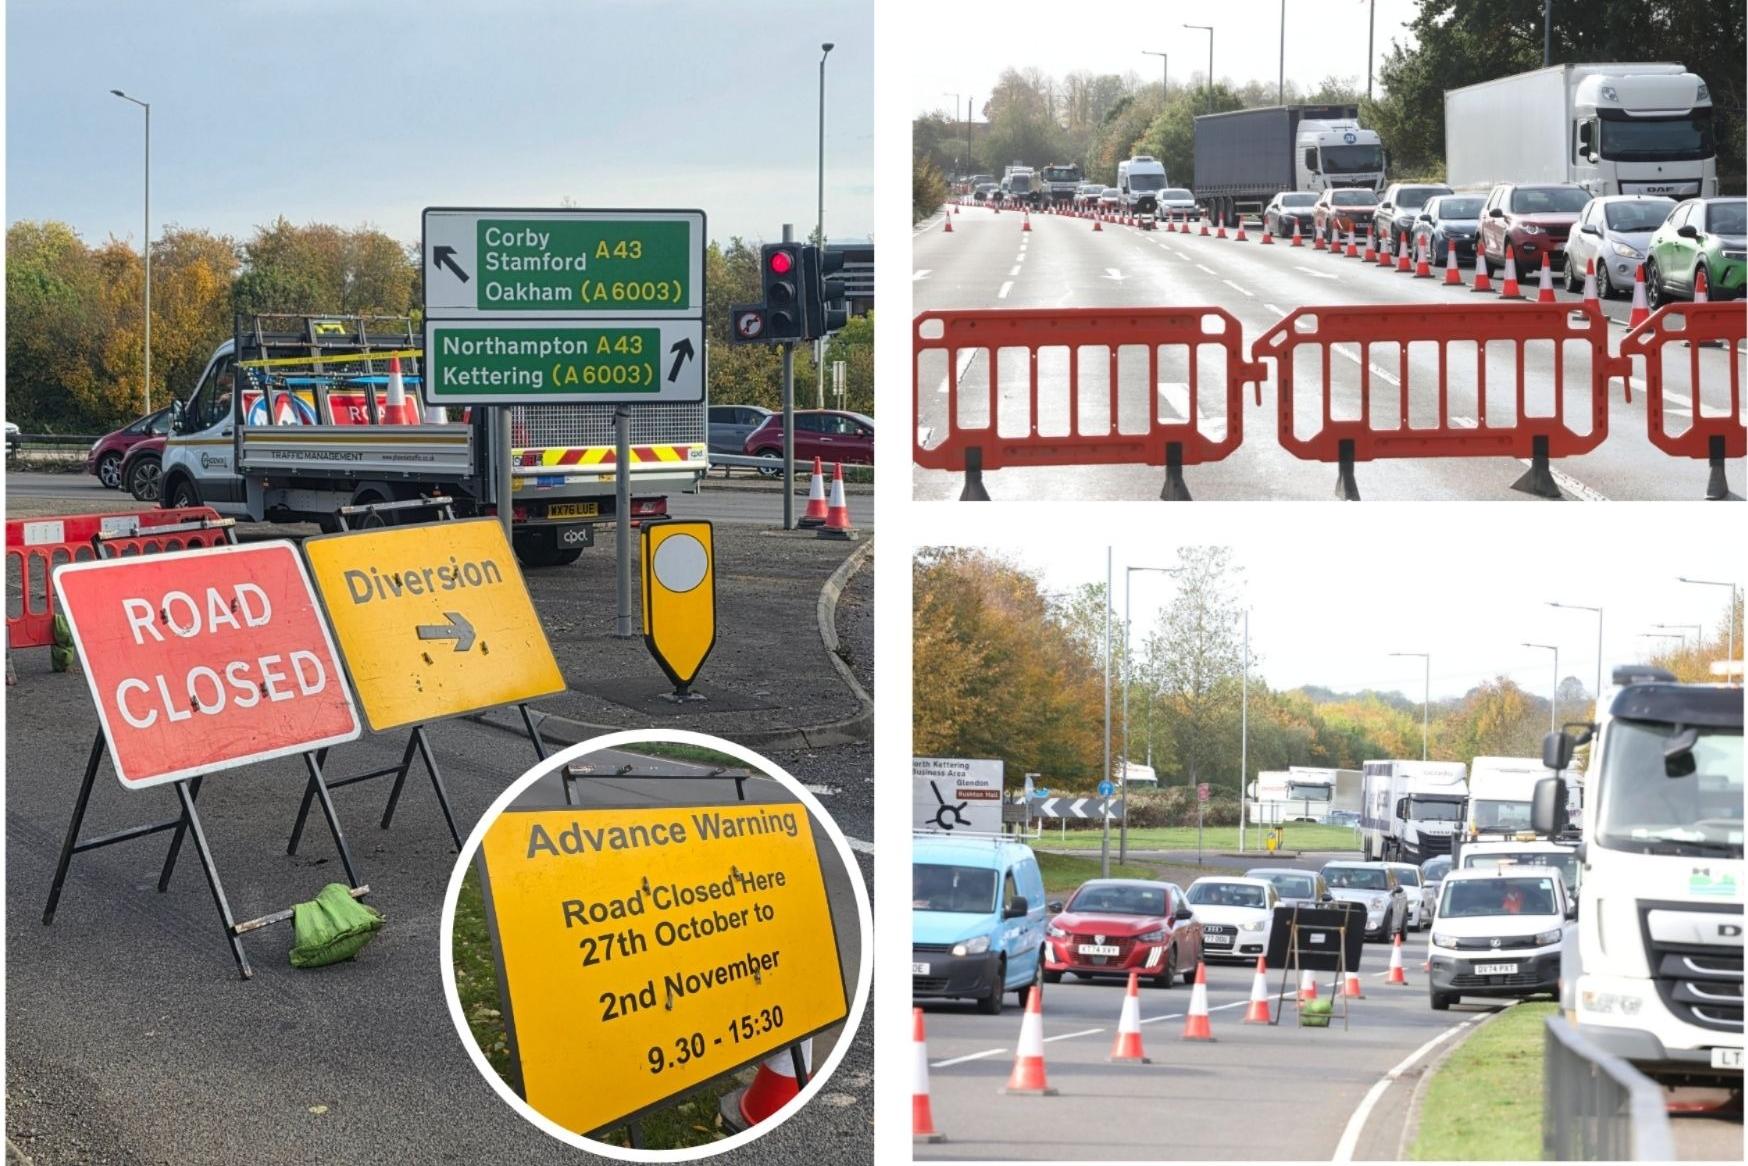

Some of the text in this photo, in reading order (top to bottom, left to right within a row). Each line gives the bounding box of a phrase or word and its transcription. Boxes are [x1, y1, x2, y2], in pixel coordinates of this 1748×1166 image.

[486, 228, 550, 248] Corby
[486, 252, 586, 271] Stamford
[486, 282, 572, 300] Oakham
[444, 336, 588, 358] Northampton
[443, 366, 543, 387] Kettering
[272, 452, 364, 461] TRAFFIC MANAGEMENT
[576, 504, 595, 514] LUE
[343, 556, 502, 604] Diversion
[122, 583, 272, 644] ROAD
[116, 650, 326, 728] CLOSED
[912, 760, 970, 770] orth Kettering
[956, 779, 989, 787] Glendon
[526, 810, 798, 858] Advance Warning
[562, 869, 786, 928] Road Closed Here
[580, 901, 774, 967] 27th October to
[599, 948, 780, 1022] 2nd November
[647, 1032, 706, 1075] 9.30
[729, 1005, 784, 1044] 15:30
